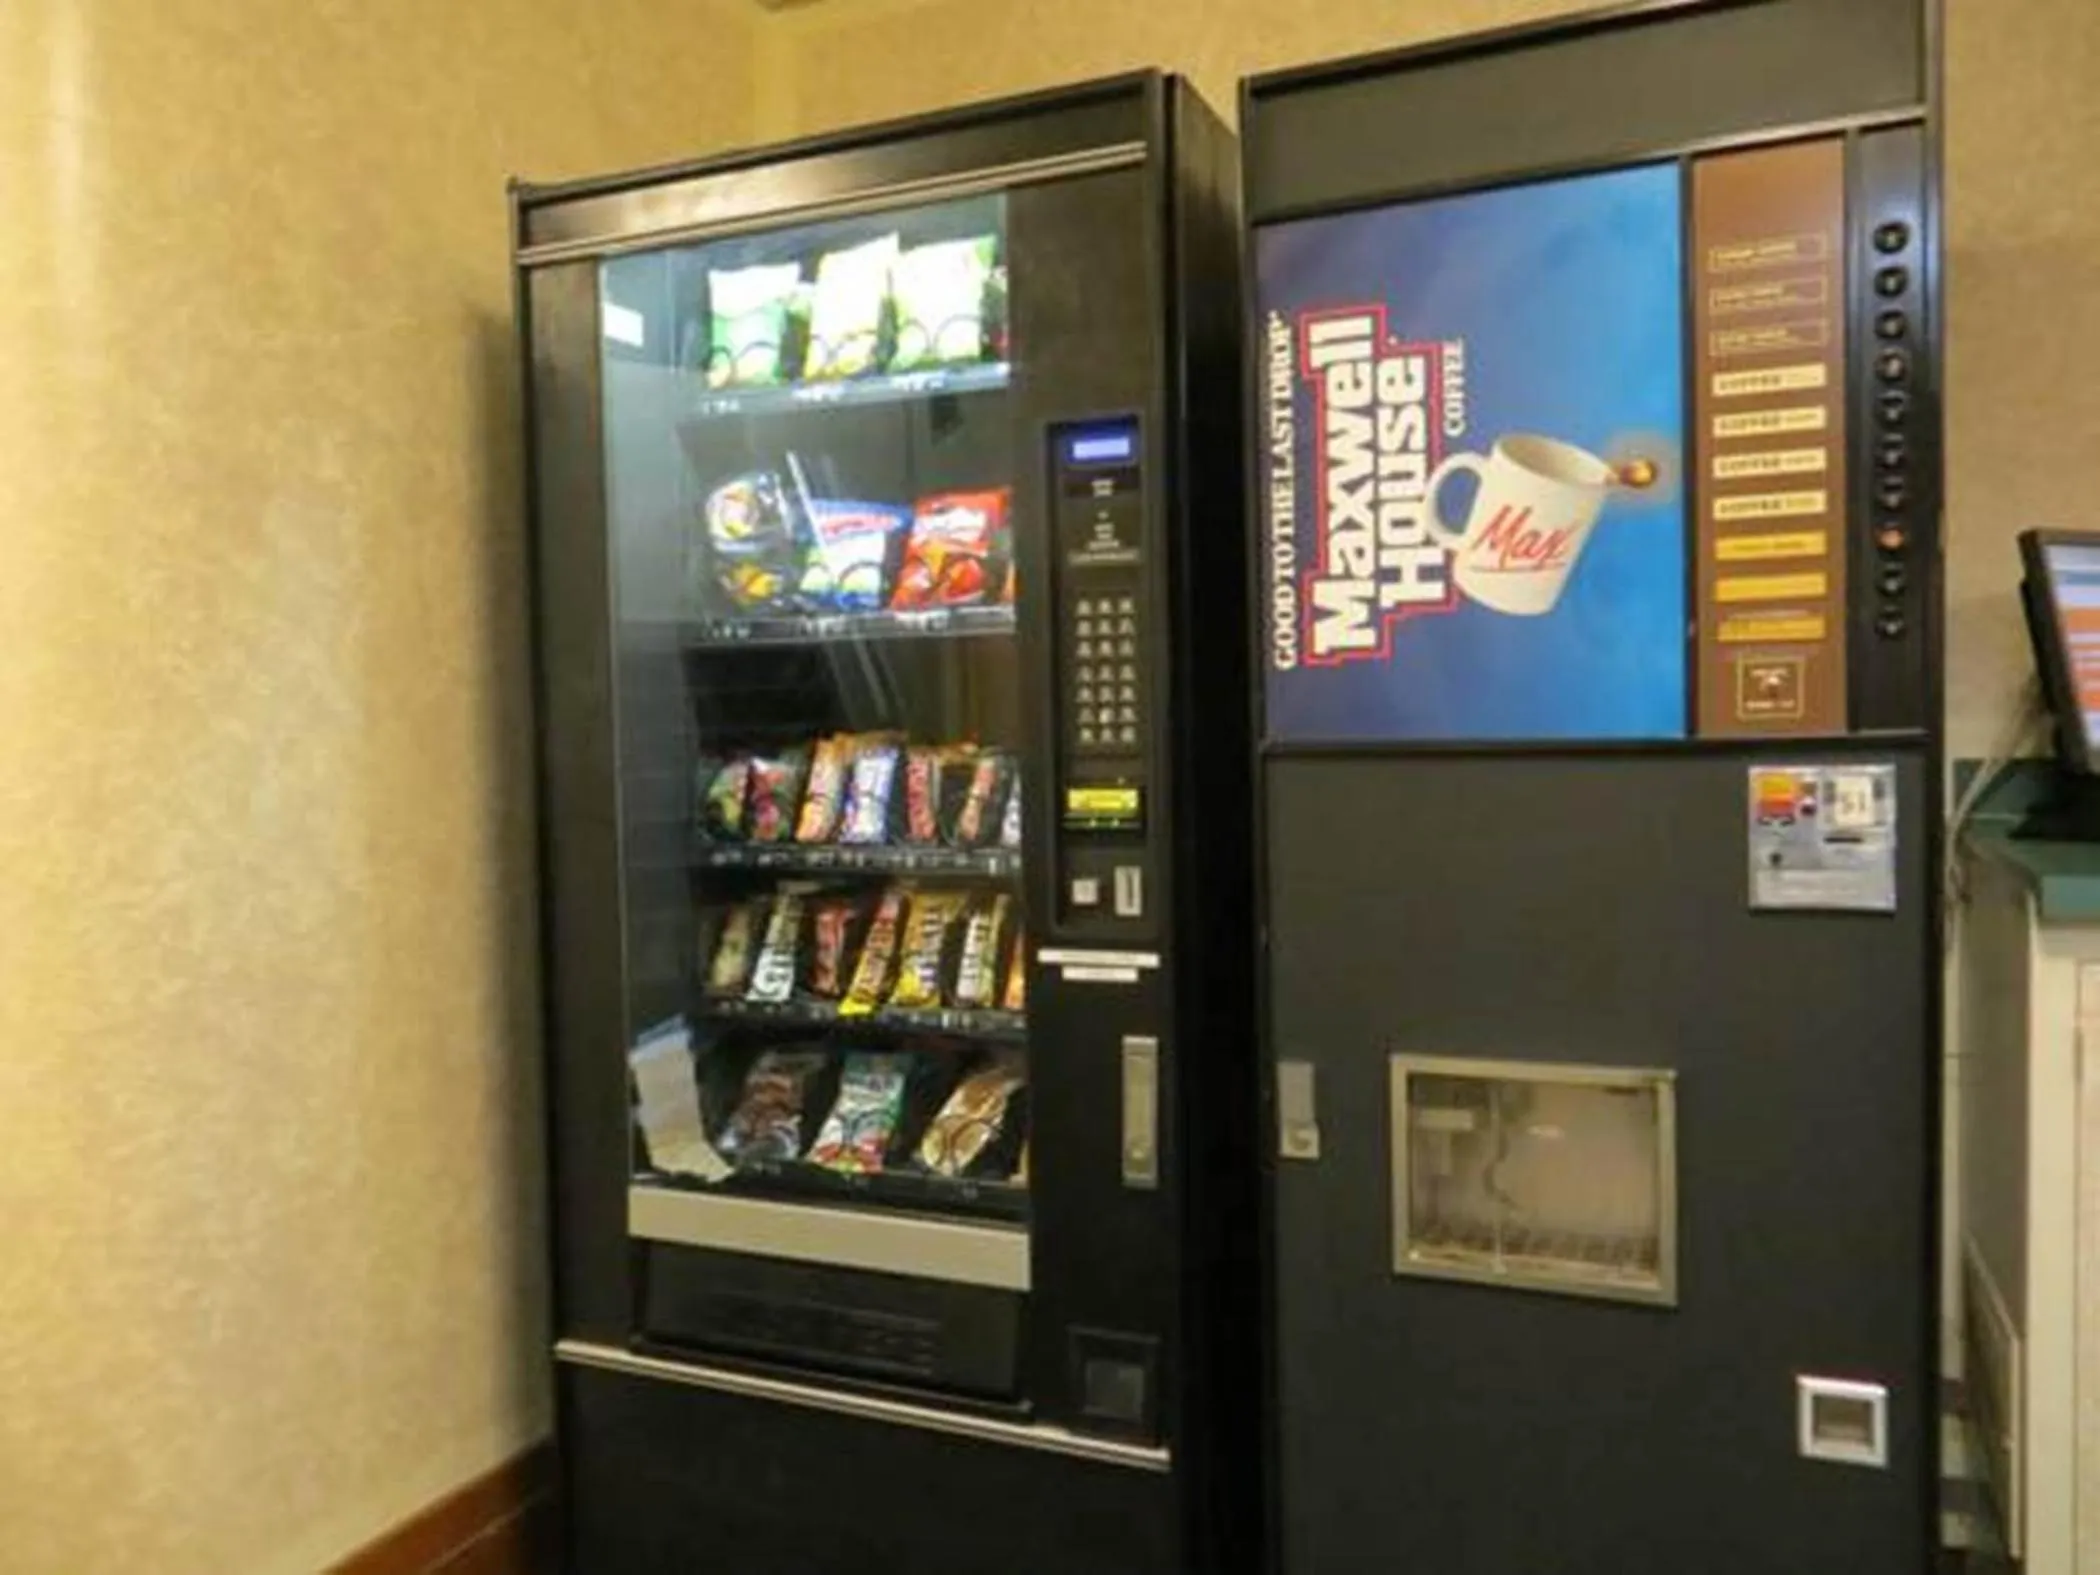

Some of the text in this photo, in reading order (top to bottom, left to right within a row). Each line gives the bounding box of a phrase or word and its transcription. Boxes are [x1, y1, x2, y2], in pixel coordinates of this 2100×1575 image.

[1271, 407, 1294, 479] LAST
[1376, 354, 1446, 609] House
[1272, 481, 1295, 543] THE
[1307, 315, 1377, 655] Maxwell
[1273, 544, 1296, 584] TO
[1273, 583, 1297, 670] GOOD
